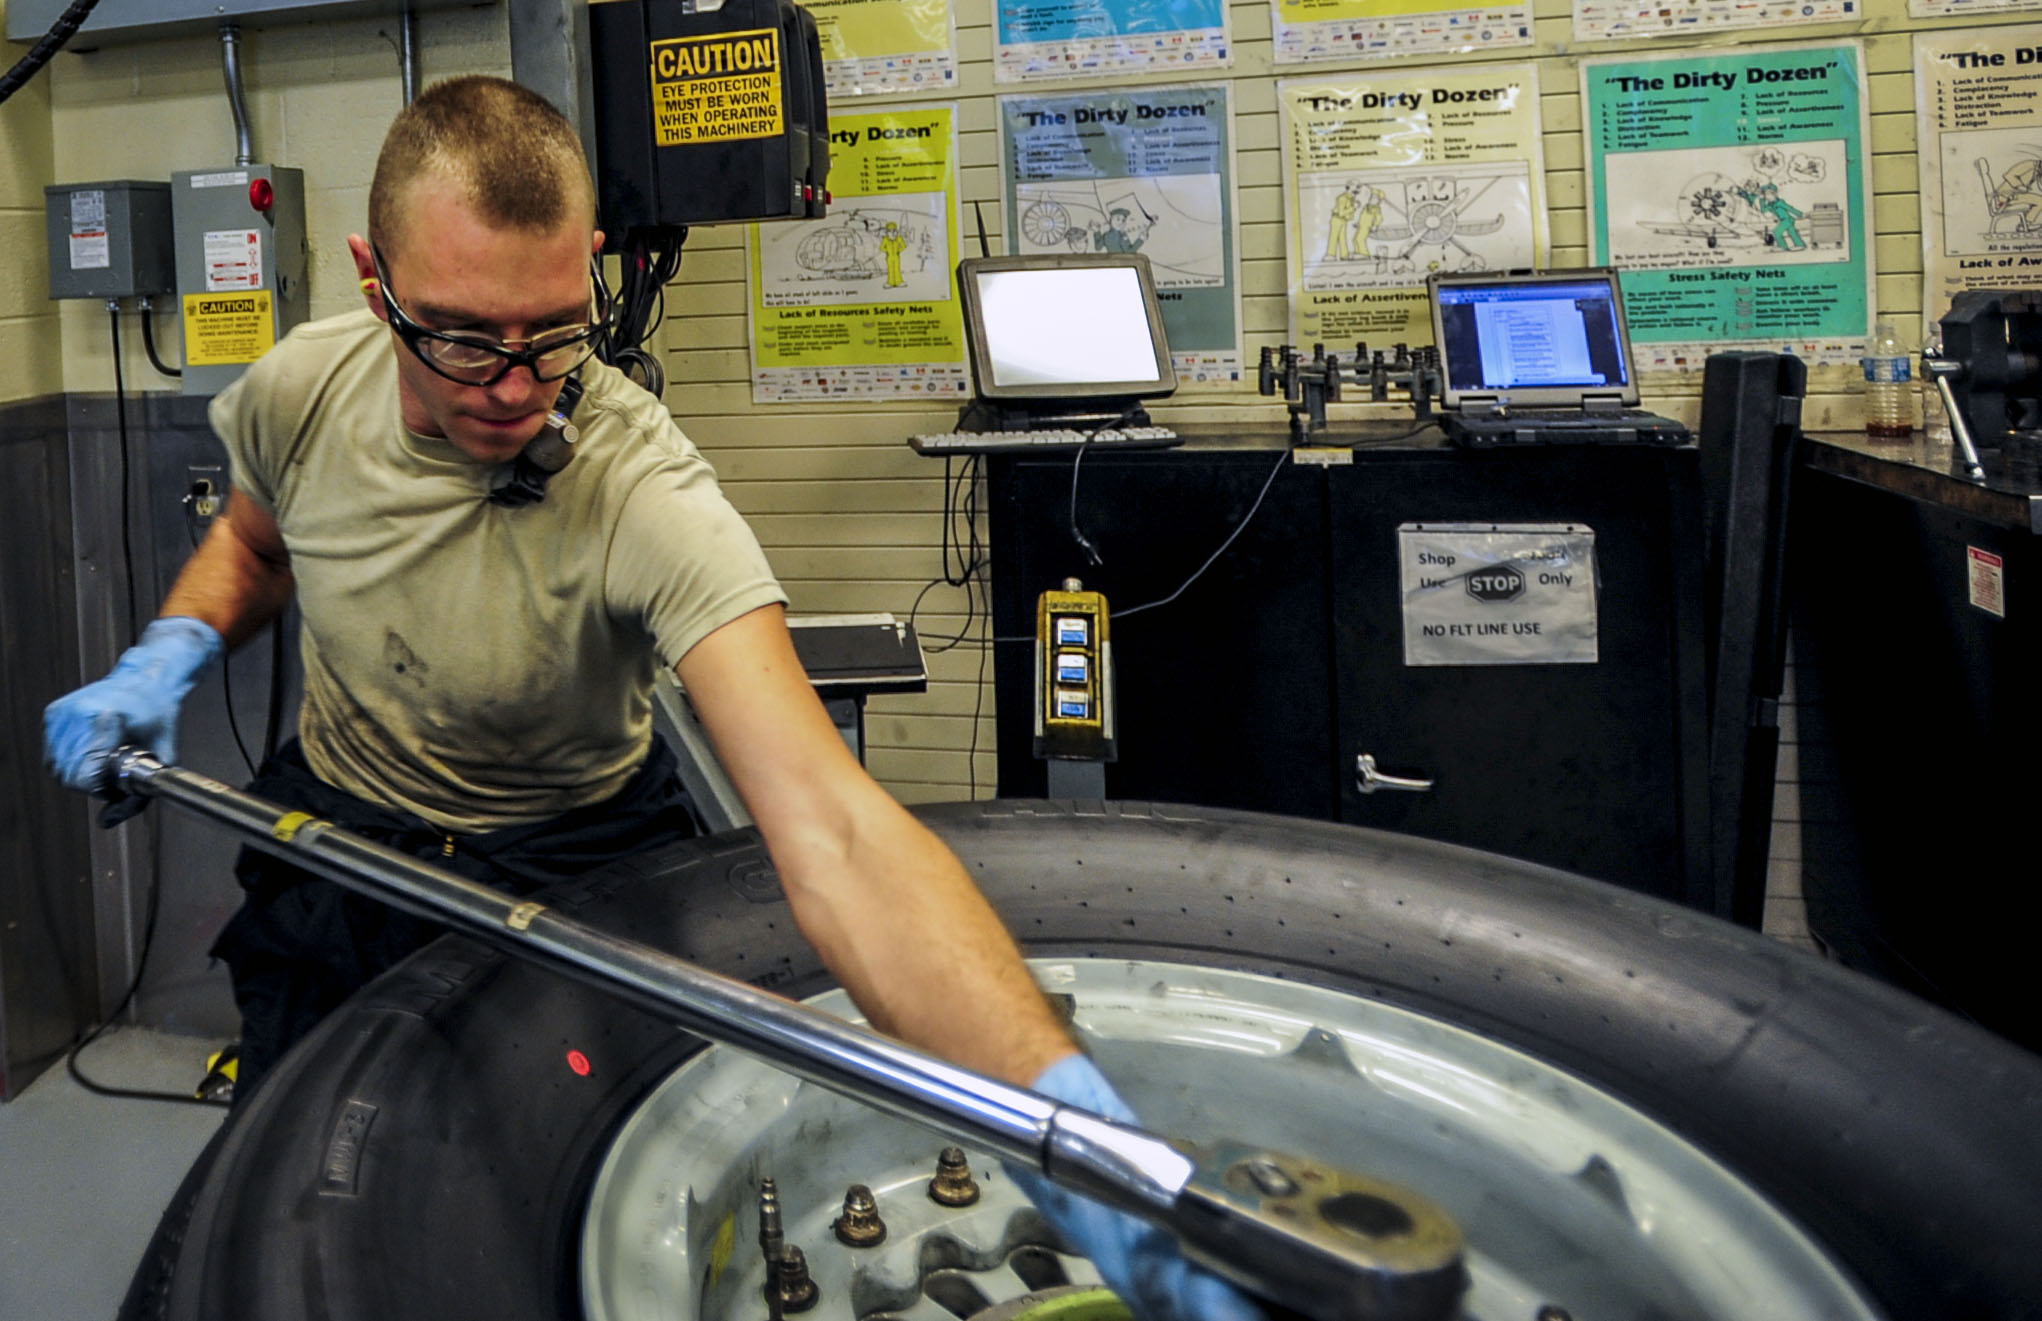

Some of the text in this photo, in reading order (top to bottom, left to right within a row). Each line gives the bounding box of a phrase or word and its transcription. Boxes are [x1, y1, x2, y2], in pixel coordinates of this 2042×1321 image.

[658, 38, 772, 78] CAUTION
[662, 76, 771, 98] EYE PROTECTION
[1673, 71, 1737, 91] Dirty
[665, 91, 770, 112] MUST BE WORN
[1362, 92, 1422, 111] Dirty
[1988, 91, 2038, 100] Knowledge
[660, 105, 777, 127] WHEN OPERATING
[1074, 108, 1128, 126] Dirty
[664, 120, 776, 141] THIS MACHINERY
[1955, 120, 1988, 128] Fatigue
[831, 130, 859, 147] rty
[1960, 259, 1992, 269] Lack
[1998, 257, 2013, 267] of
[1669, 270, 1786, 282] Stress Safety Nets
[1157, 293, 1182, 301] Nets
[1313, 292, 1430, 304] Lack of Assertiven
[200, 301, 253, 313] CAUTION
[779, 310, 802, 319] Lack
[805, 309, 816, 318] of
[820, 308, 870, 317] Resources
[873, 306, 905, 316] Safety
[1418, 553, 1456, 567] Shop
[1471, 576, 1520, 592] STOP
[1538, 572, 1573, 587] Only
[1423, 622, 1542, 637] NO FLT LINE USE
